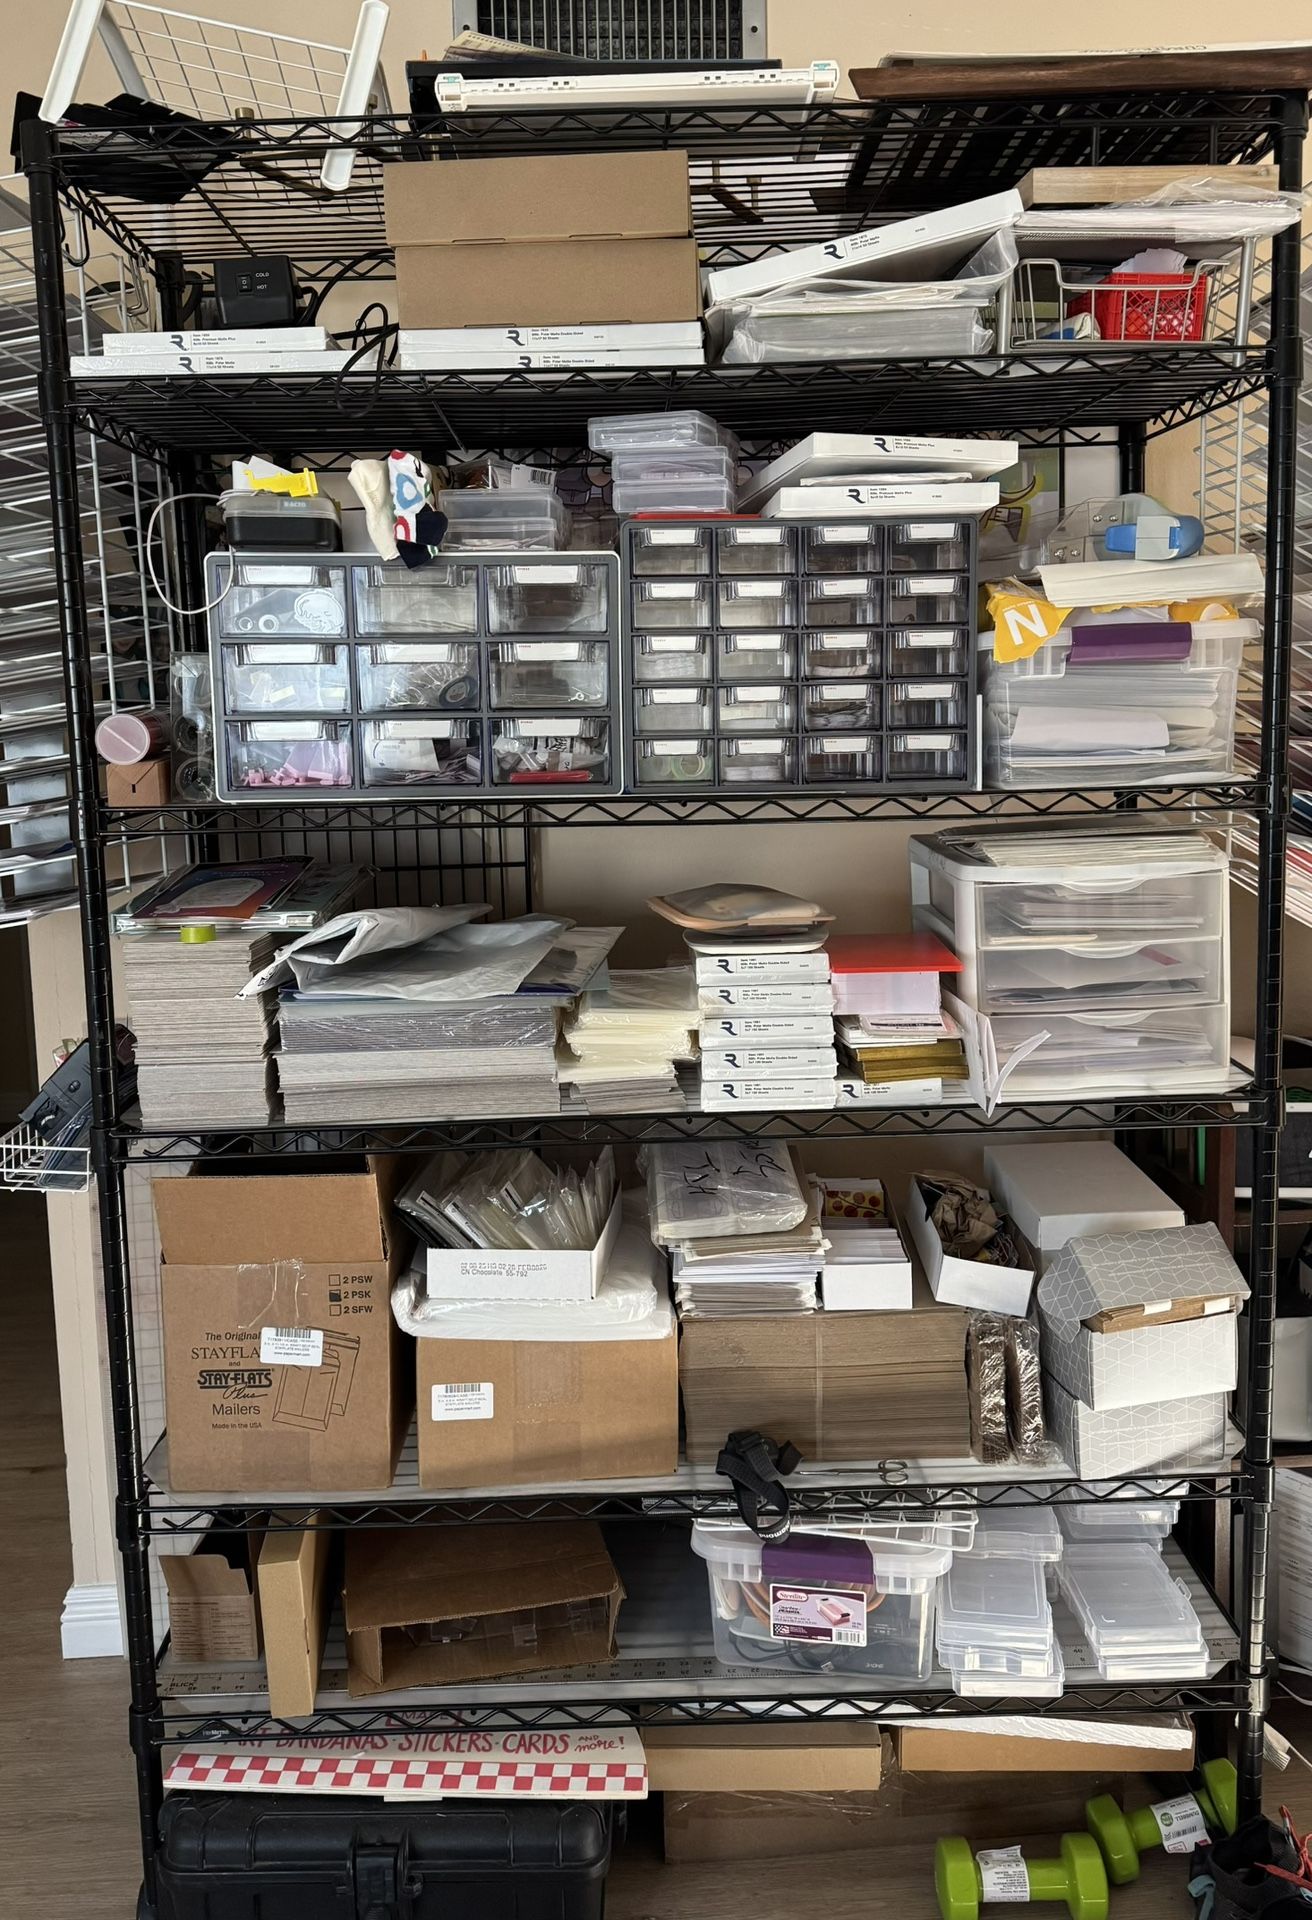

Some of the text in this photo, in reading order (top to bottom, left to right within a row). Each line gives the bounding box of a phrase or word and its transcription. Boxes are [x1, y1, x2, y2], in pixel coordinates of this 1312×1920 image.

[1003, 602, 1048, 646] N
[343, 1275, 372, 1284] 2 PSW
[344, 1290, 371, 1299] 2 PSK
[344, 1306, 373, 1314] 2 SFW
[205, 1332, 223, 1341] The
[224, 1331, 261, 1342] Original
[191, 1347, 261, 1360] STAYFLA
[222, 1384, 268, 1400] Plus
[212, 1404, 261, 1415] Mailers
[276, 1728, 388, 1750] BANDANAS
[400, 1731, 494, 1752] STICKERS
[502, 1734, 570, 1754] CARDS
